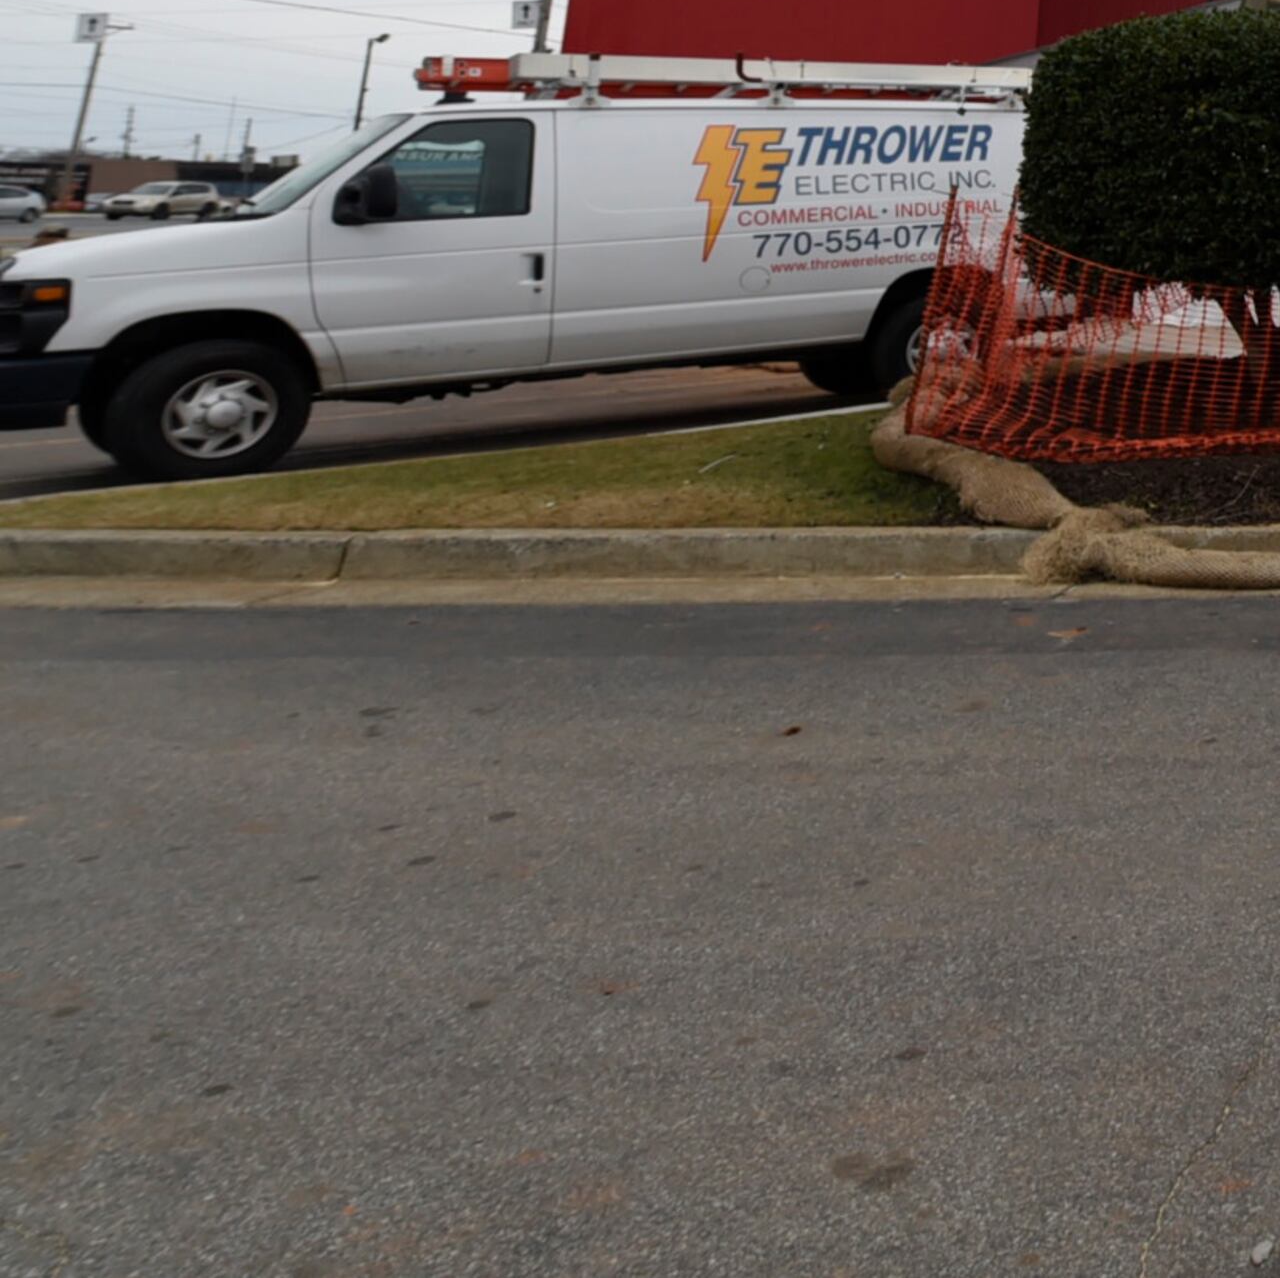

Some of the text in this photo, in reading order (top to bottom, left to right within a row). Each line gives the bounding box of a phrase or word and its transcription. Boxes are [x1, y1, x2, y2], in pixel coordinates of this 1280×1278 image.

[797, 125, 993, 166] THROWER
[795, 169, 997, 195] ELECTRIC INC.
[737, 205, 878, 227] COMMERCIAL
[770, 251, 950, 273] www.throwerelectric.co
